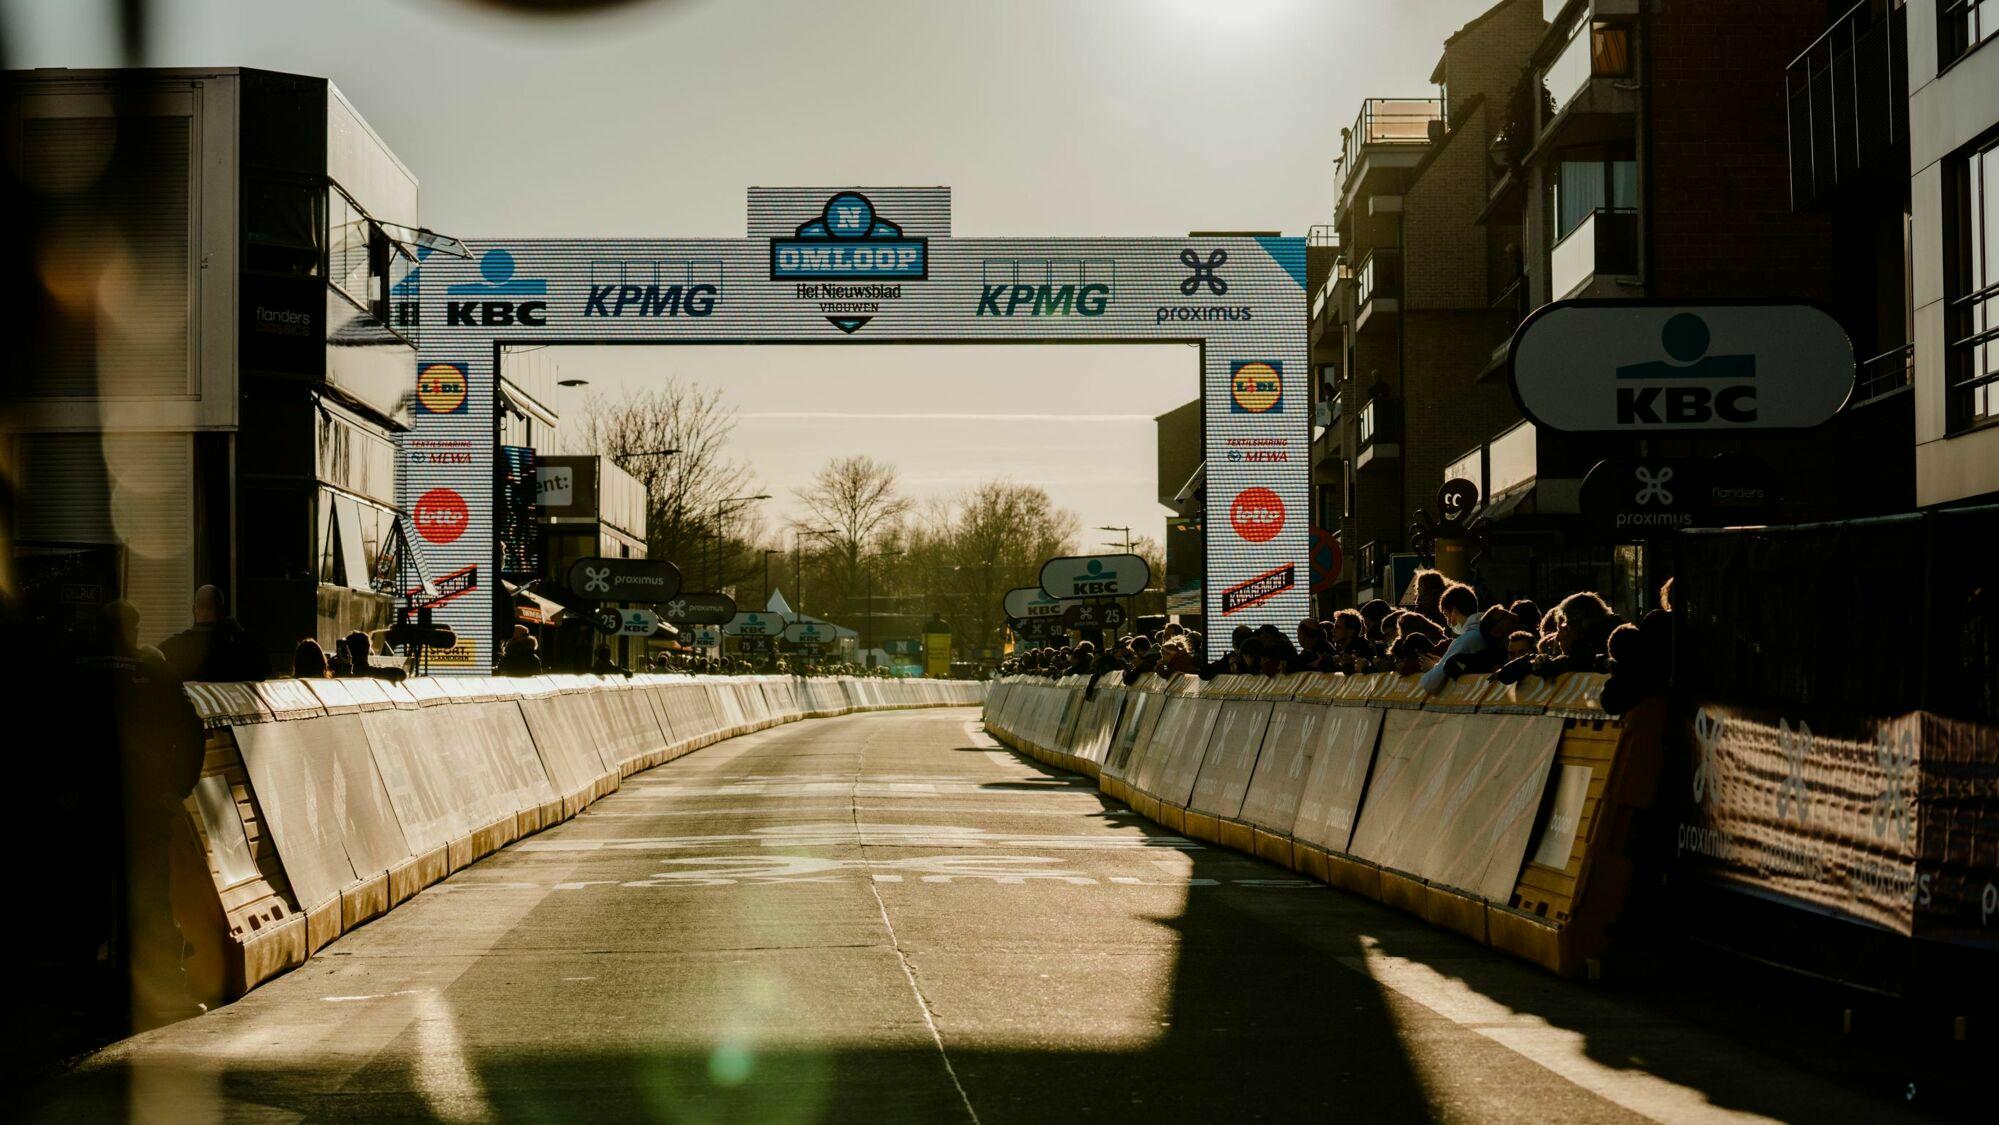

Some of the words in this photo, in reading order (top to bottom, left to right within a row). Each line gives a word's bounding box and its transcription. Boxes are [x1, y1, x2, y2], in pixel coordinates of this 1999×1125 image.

[836, 206, 861, 228] N
[779, 247, 917, 271] OMLOOP
[796, 284, 819, 299] Het
[822, 284, 901, 299] Nieuwsblad
[584, 283, 718, 318] KPMG
[819, 302, 880, 312] VROUWEN
[976, 283, 1110, 317] KPMG
[256, 305, 311, 325] flanders
[447, 301, 547, 326] KBC
[1156, 304, 1251, 325] proximus
[1616, 385, 1757, 425] KBC
[428, 452, 472, 464] MEWA
[1244, 450, 1289, 463] MEWA
[1711, 486, 1765, 499] flanders
[1616, 511, 1692, 528] proximus
[614, 575, 664, 588] proximus
[1073, 581, 1119, 596] KBC
[1229, 570, 1287, 608] KWAREMONT
[1027, 605, 1061, 615] KBC
[1105, 608, 1121, 624] 25
[601, 614, 616, 629] 25
[624, 625, 649, 633] KBC
[1050, 624, 1062, 636] 50
